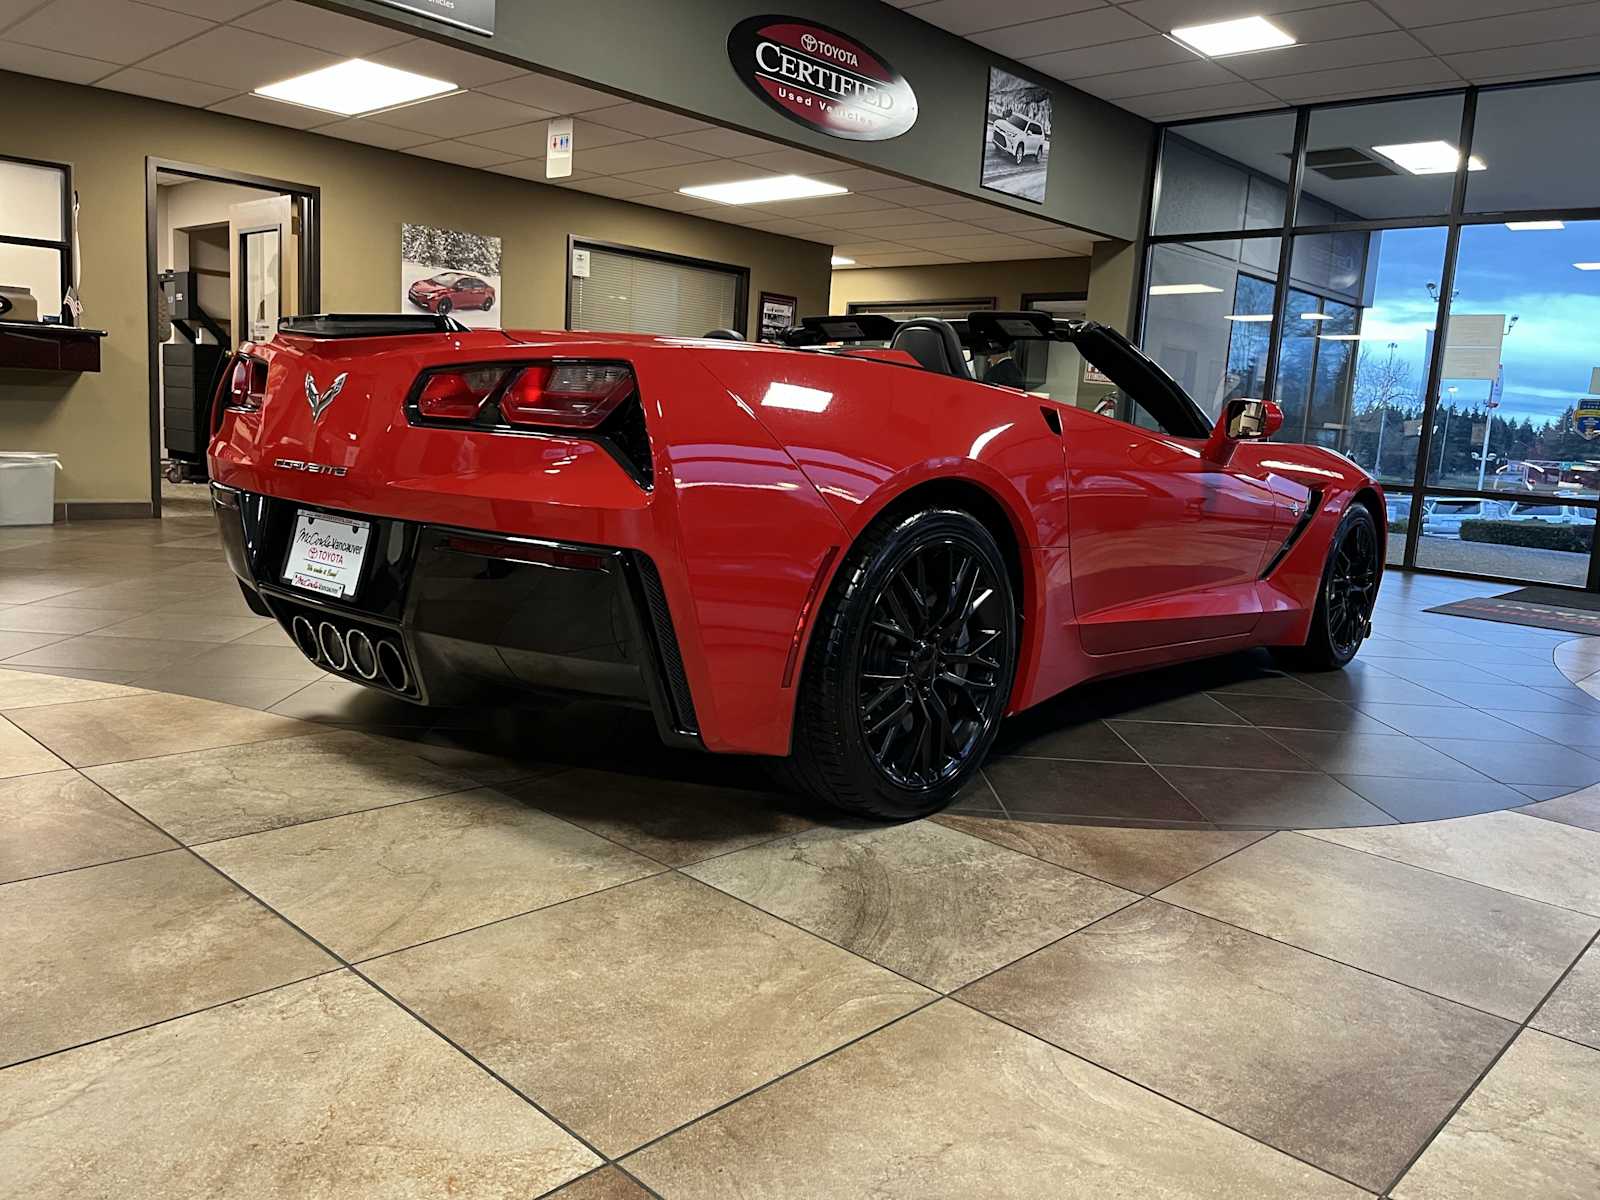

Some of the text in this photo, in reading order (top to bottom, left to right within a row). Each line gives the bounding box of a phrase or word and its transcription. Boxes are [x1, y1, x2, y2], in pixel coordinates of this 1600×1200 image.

[818, 40, 859, 68] TOYOTA
[755, 41, 895, 111] CERTIFIED
[778, 87, 812, 107] Used
[274, 458, 348, 477] CORVETTE
[319, 550, 344, 565] TOYOTA
